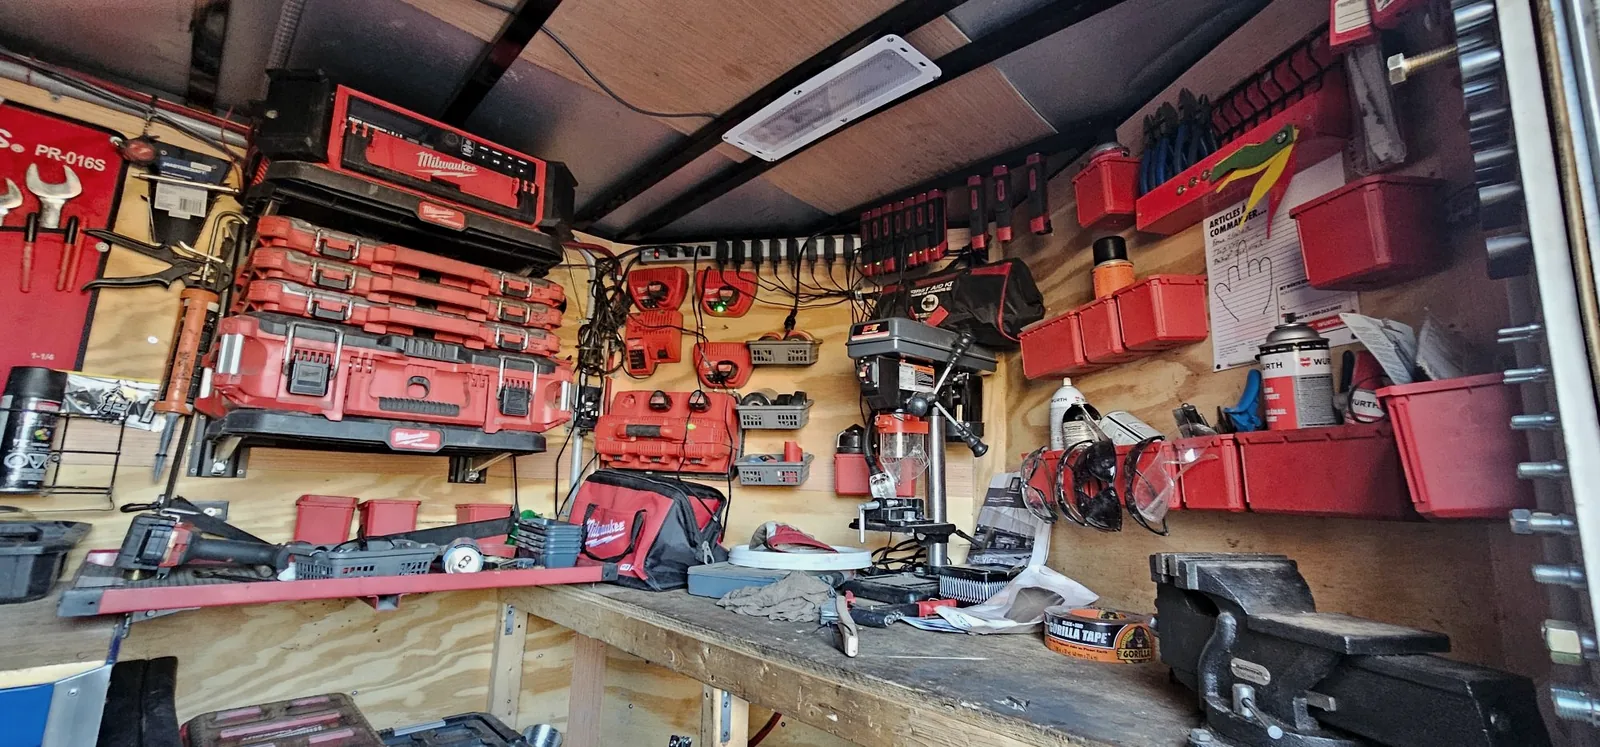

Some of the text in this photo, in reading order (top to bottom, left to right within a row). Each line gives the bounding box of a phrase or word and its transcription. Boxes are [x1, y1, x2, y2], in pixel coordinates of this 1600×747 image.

[34, 143, 107, 172] PR-016S
[415, 151, 478, 173] Milwaukee
[1209, 207, 1241, 229] ARTICLES
[586, 518, 626, 538] Milwaukee
[1049, 621, 1108, 644] GORILLA TAPE
[1122, 649, 1152, 659] GORILLA
